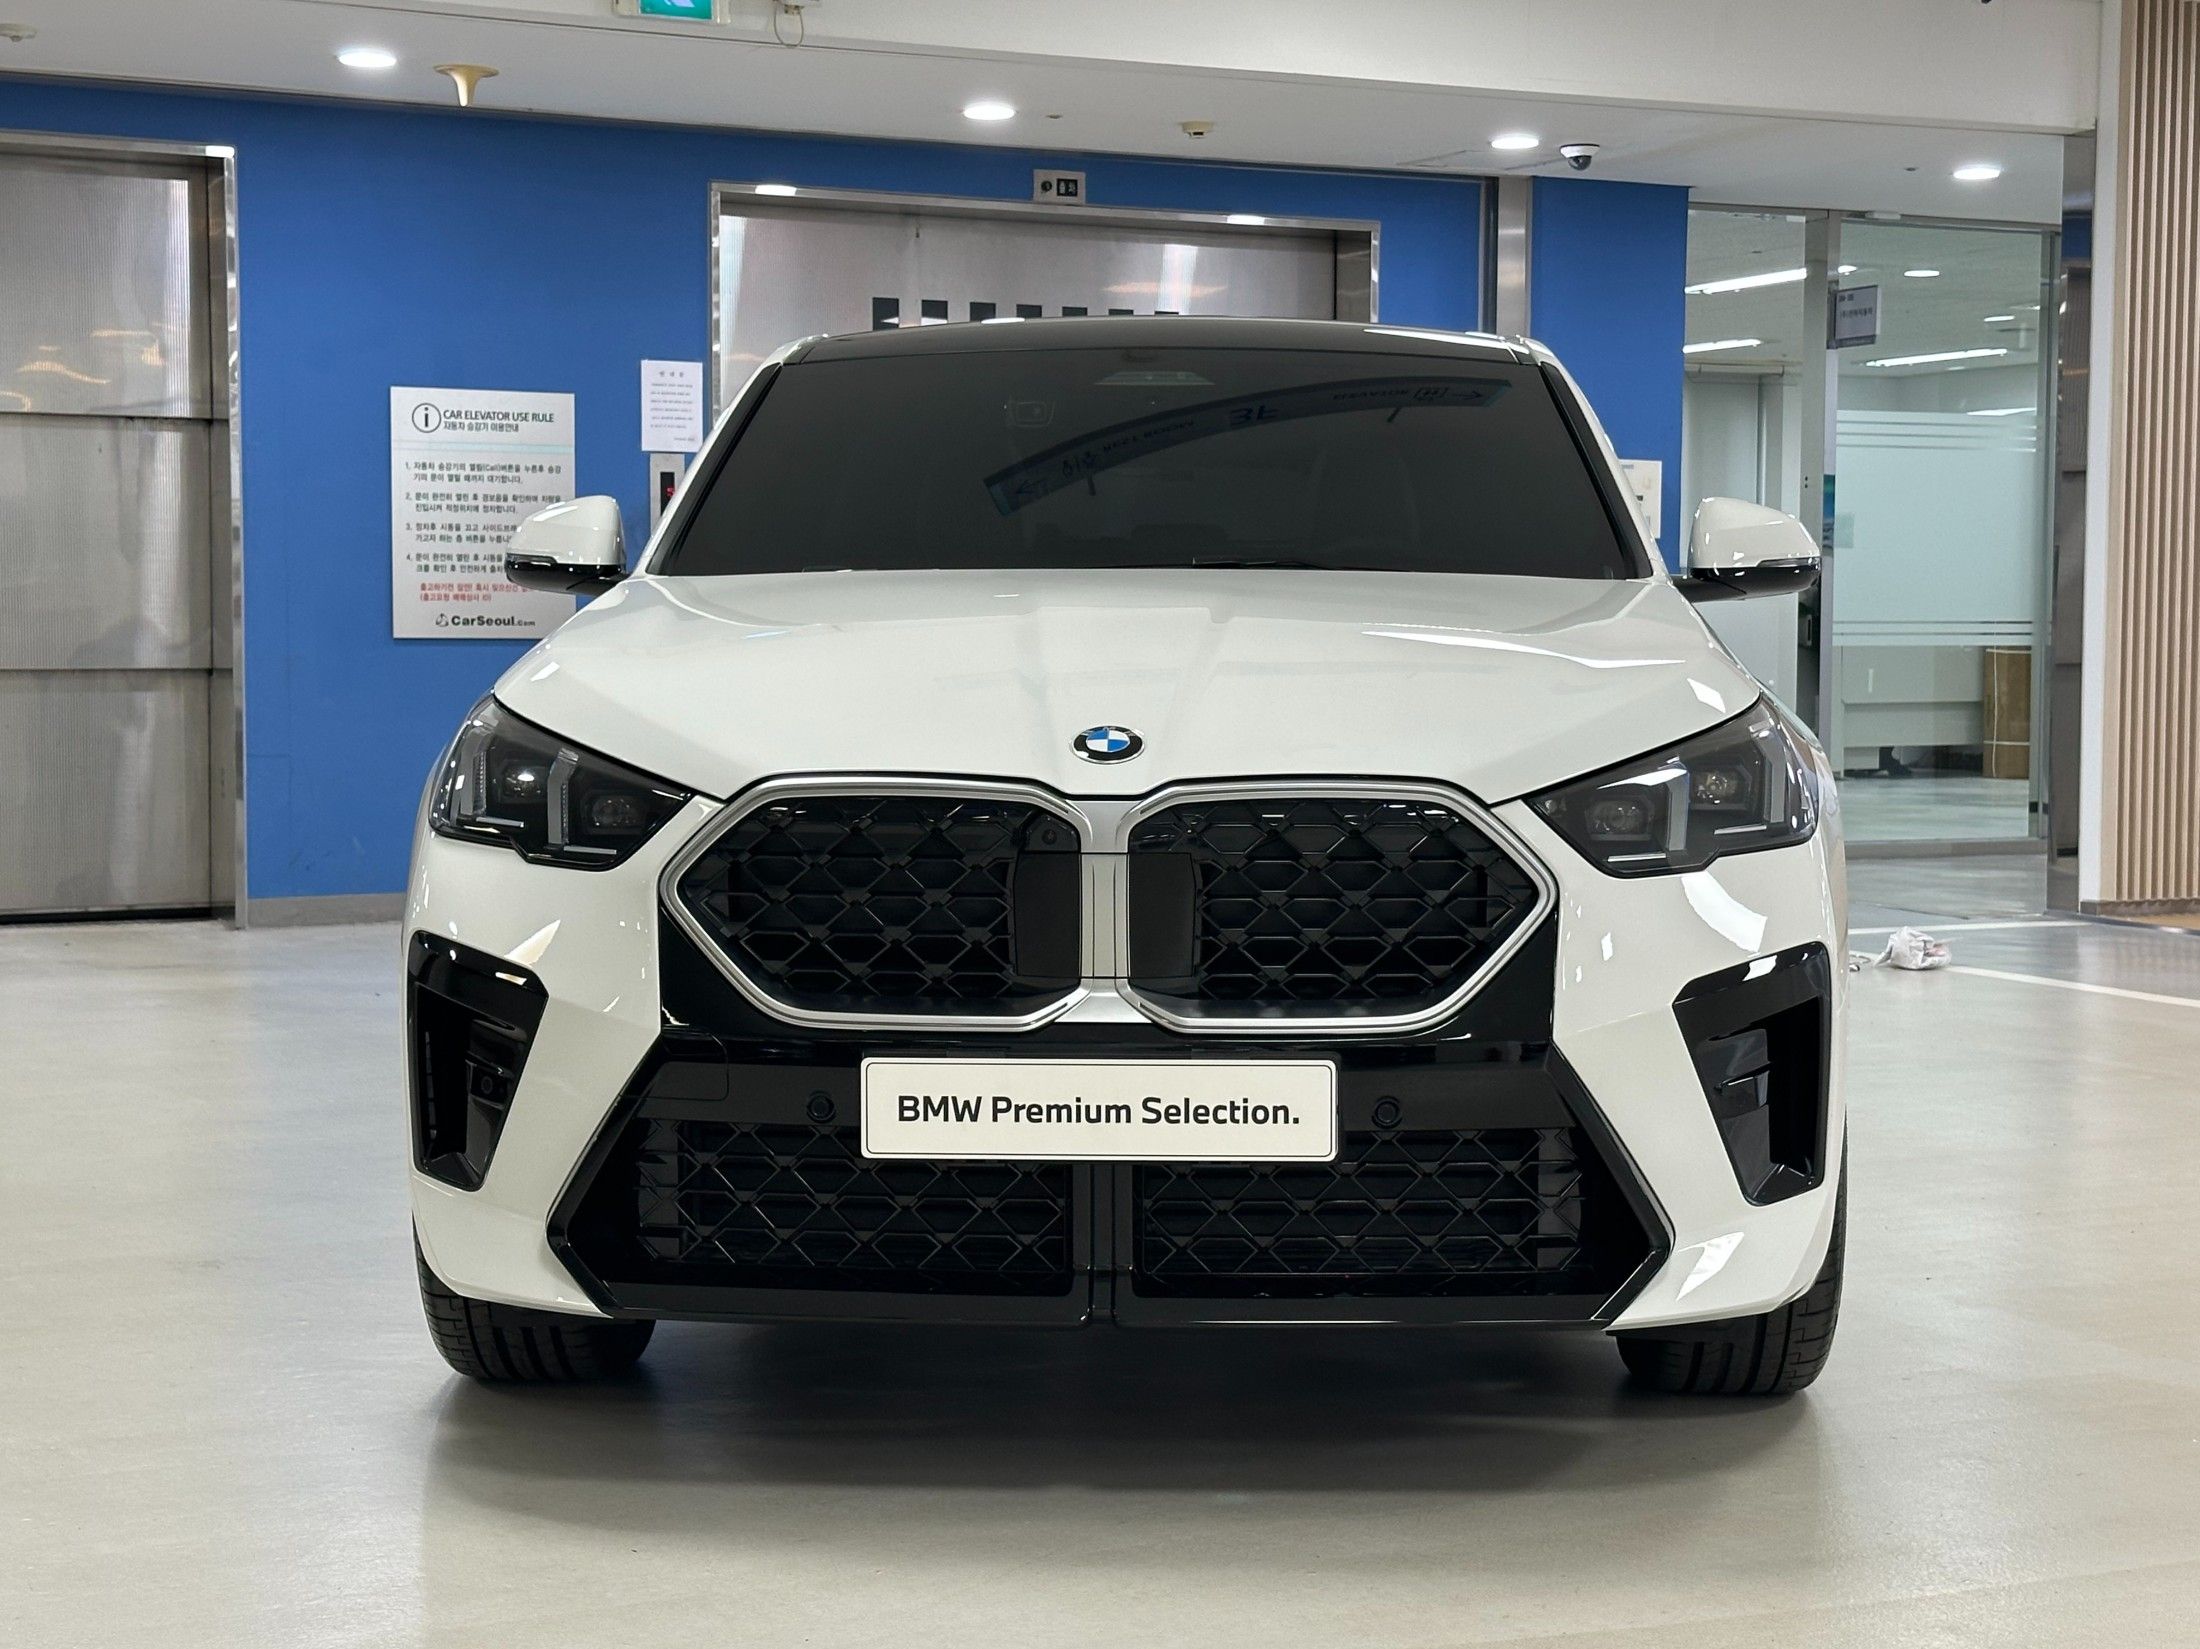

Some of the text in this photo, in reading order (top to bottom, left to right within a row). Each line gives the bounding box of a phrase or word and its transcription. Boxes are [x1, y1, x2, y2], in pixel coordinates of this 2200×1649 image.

[443, 409, 554, 423] CAR ELEVATOR USE RULE
[443, 422, 465, 431] 자동차
[467, 422, 489, 432] 승강기
[414, 462, 435, 472] 자동차
[489, 535, 512, 544] 누릅니
[899, 1096, 1300, 1126] BMW Premium Selection.
